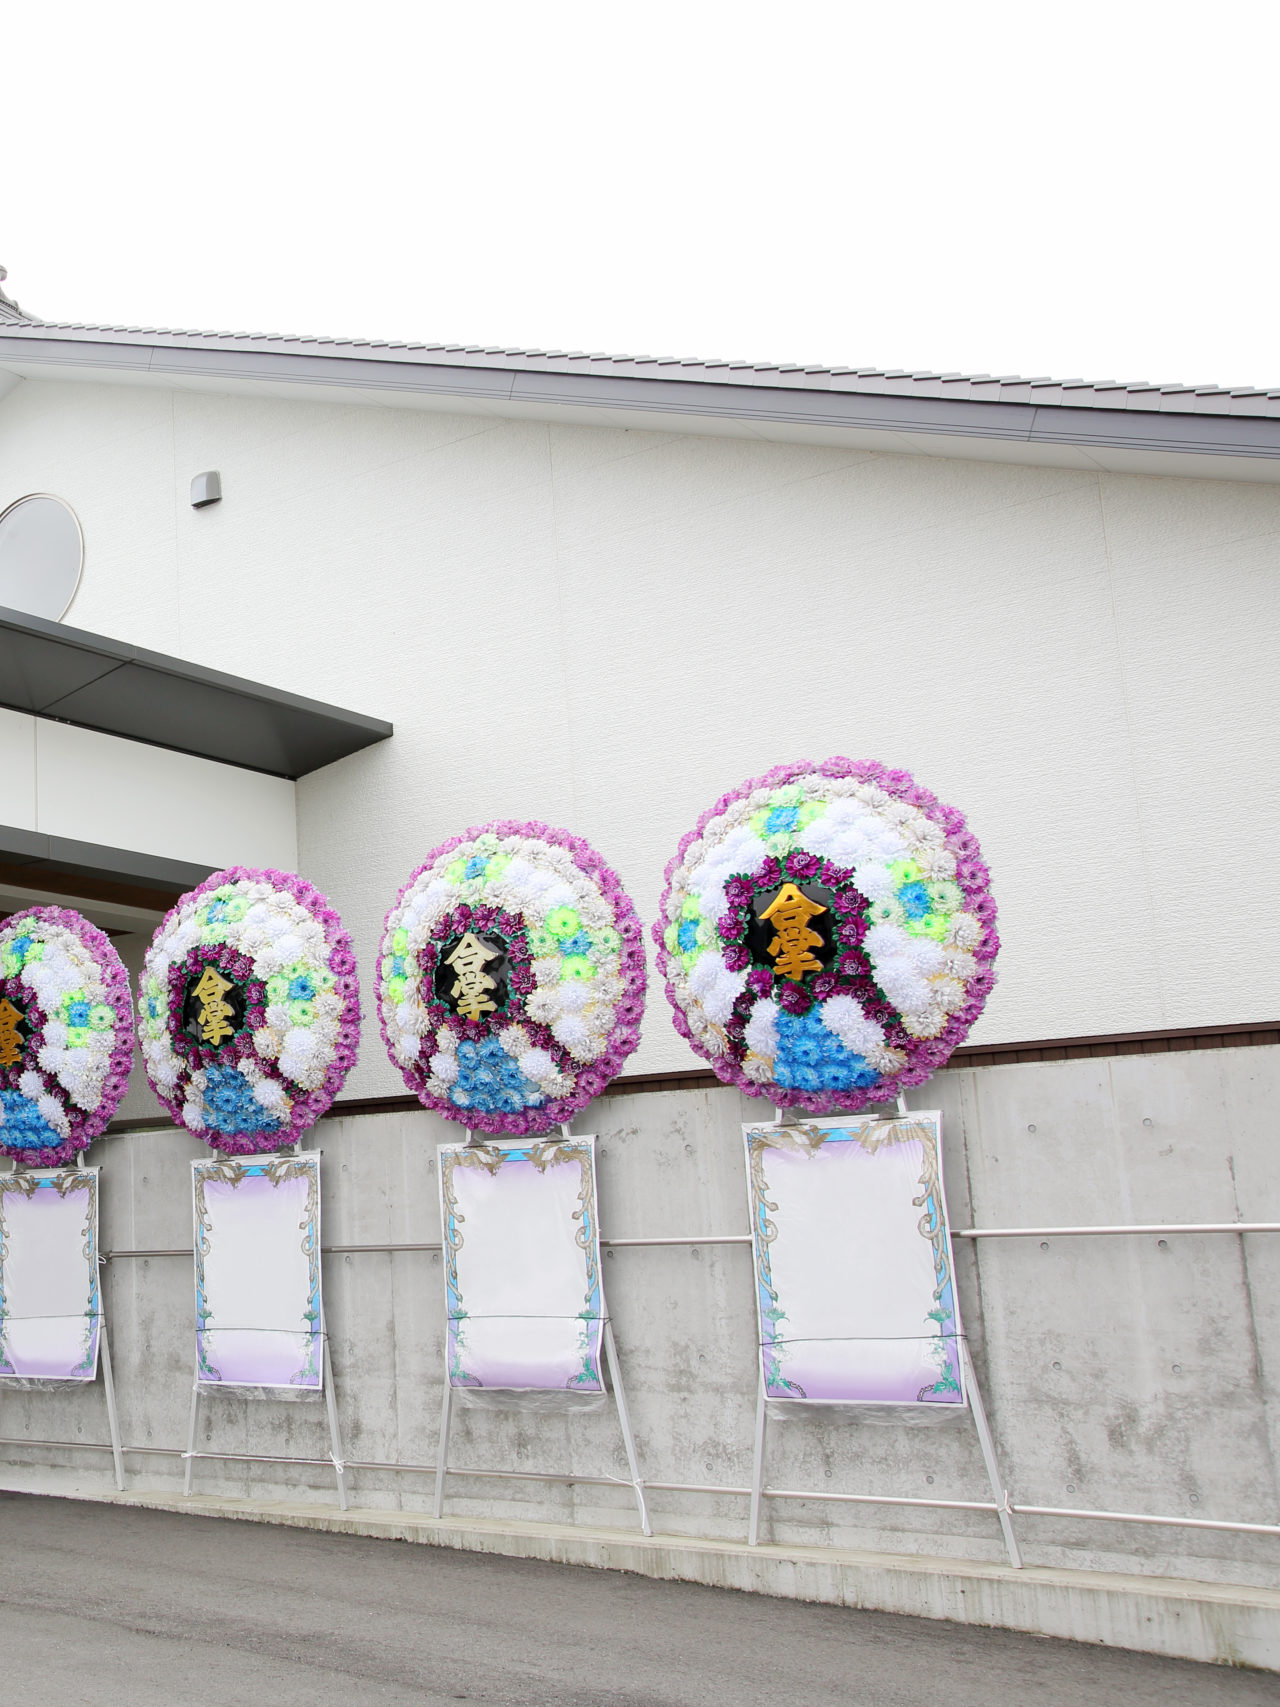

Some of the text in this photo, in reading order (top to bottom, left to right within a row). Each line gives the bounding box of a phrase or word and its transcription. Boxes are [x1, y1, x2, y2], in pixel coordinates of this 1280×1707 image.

[759, 883, 828, 981] 合掌
[191, 966, 235, 1045] 合掌
[444, 933, 500, 1021] 合掌
